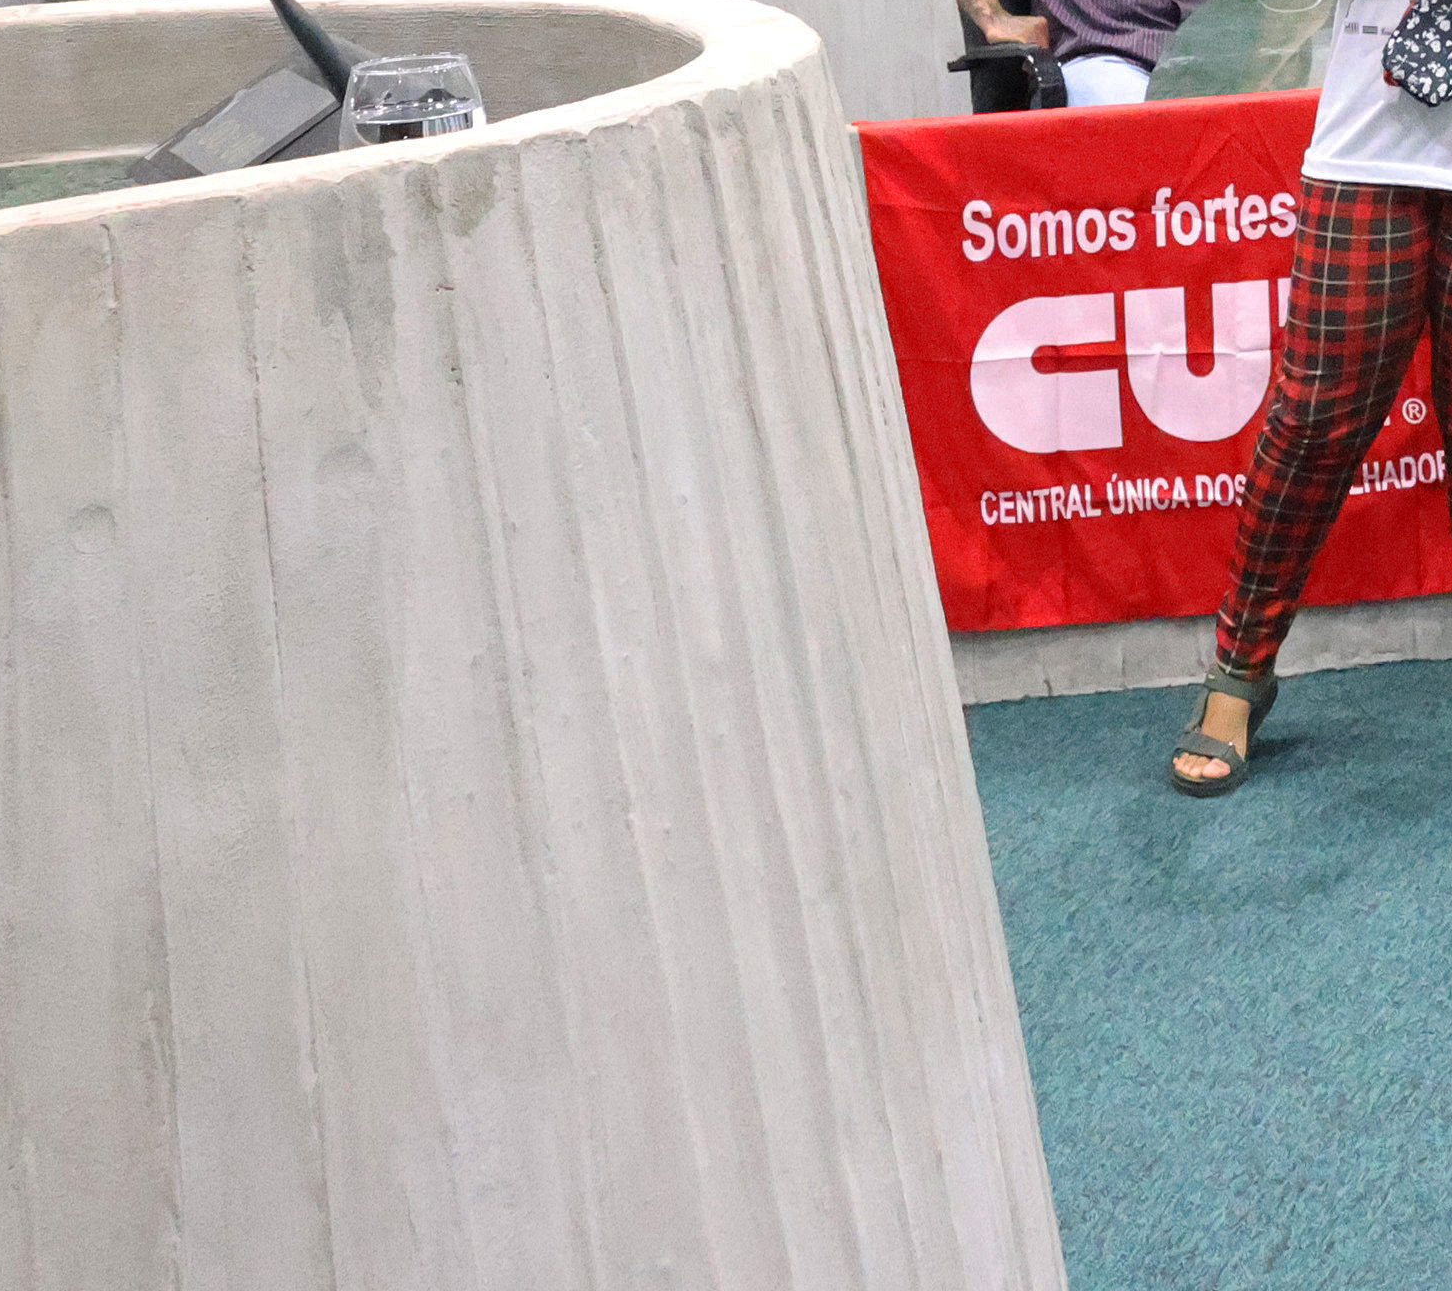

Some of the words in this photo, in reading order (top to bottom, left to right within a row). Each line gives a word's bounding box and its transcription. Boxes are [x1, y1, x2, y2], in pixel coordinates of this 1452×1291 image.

[962, 200, 1137, 262] Somos
[1151, 183, 1297, 247] fortes
[970, 278, 1292, 454] CU
[980, 483, 1101, 526] CENTRAL
[1106, 473, 1191, 515] ÚNICA
[1195, 474, 1246, 507] DOS
